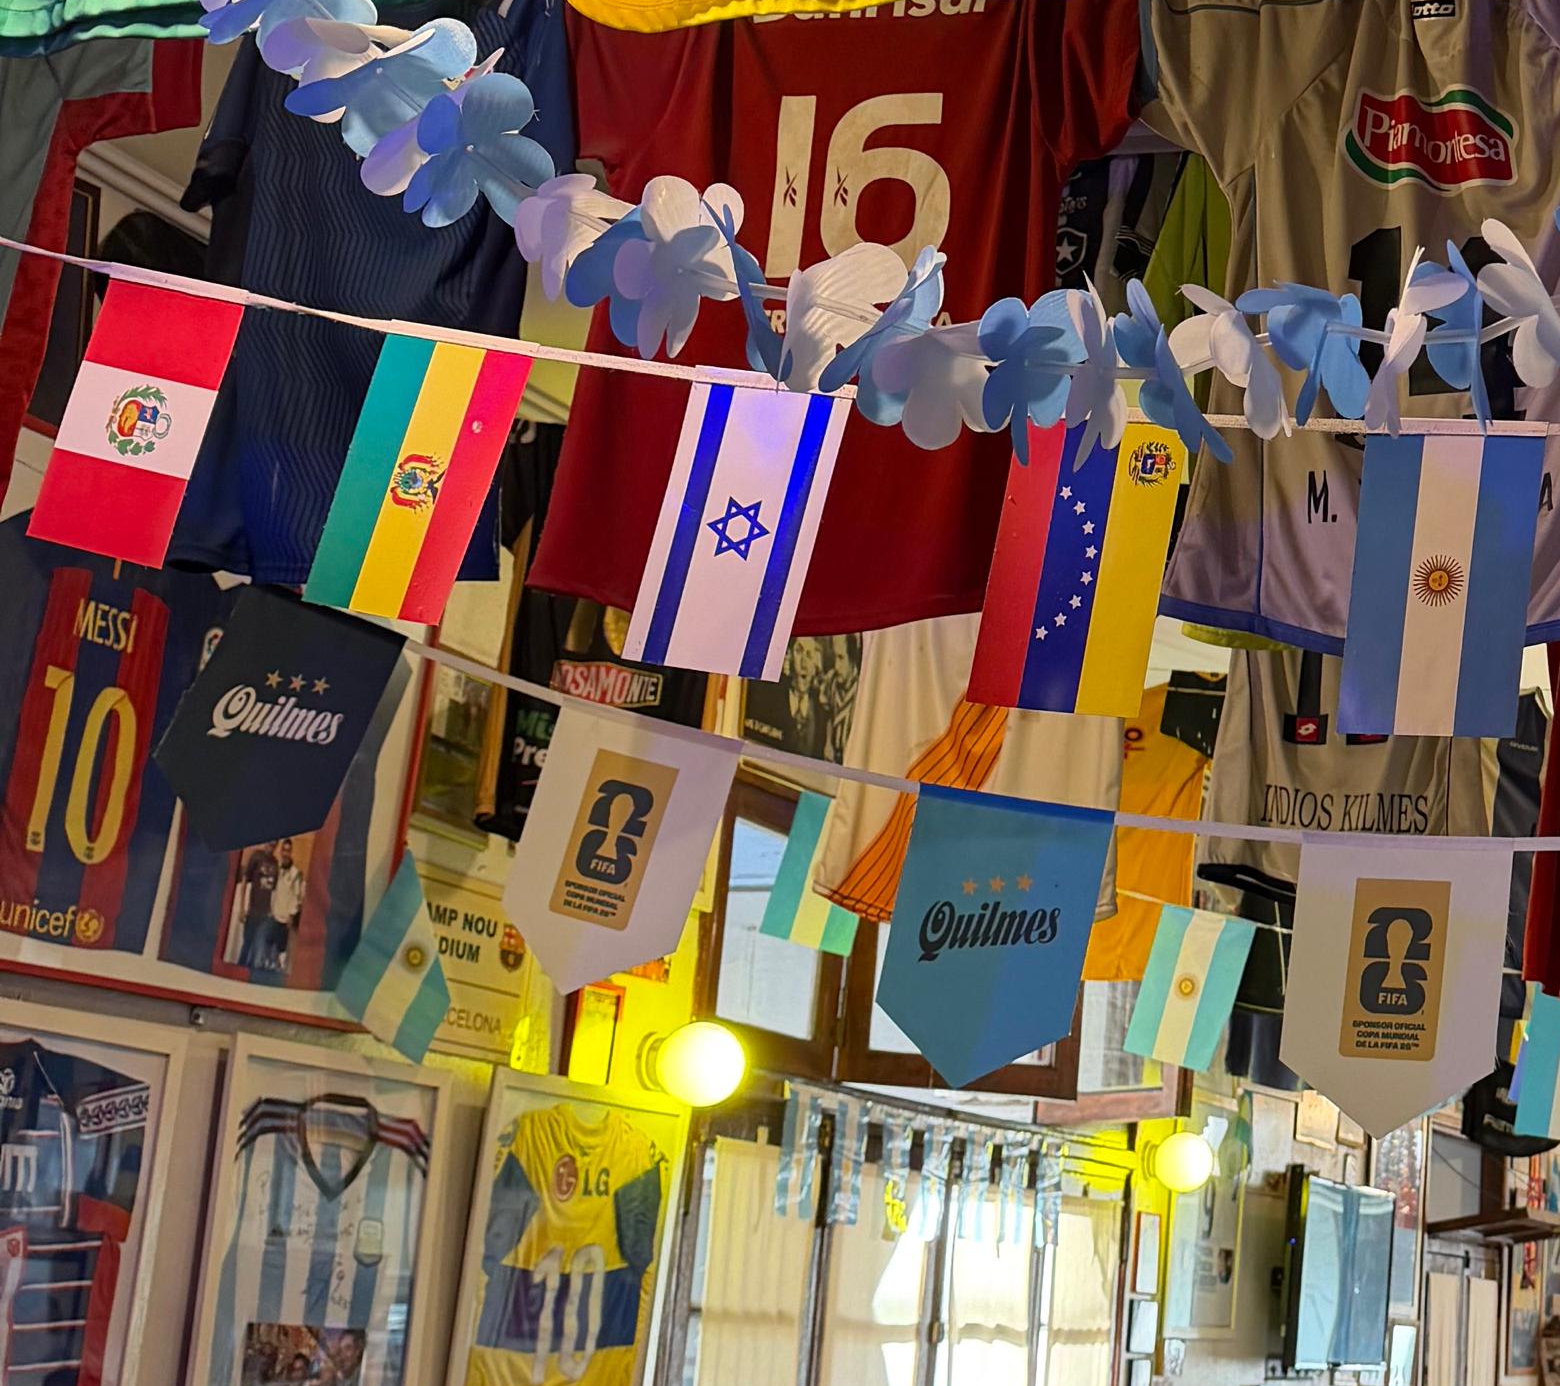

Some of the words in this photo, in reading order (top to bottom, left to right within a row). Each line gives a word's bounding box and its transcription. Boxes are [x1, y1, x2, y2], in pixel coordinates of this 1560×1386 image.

[1413, 2, 1455, 16] otto
[1360, 102, 1507, 166] Piamontesa
[766, 92, 951, 280] 16
[73, 599, 138, 654] MESSI
[206, 682, 345, 745] Quilmes
[26, 664, 138, 865] 10
[1260, 784, 1335, 831] INDIOS
[1338, 791, 1429, 835] KILMES
[590, 857, 616, 876] FIFA
[0, 898, 77, 937] unicef
[426, 900, 458, 927] AMP
[462, 912, 498, 938] NOU
[917, 899, 1060, 962] Quilmes
[438, 935, 481, 964] DIUM
[1378, 992, 1408, 1006] FIFA
[447, 1006, 502, 1035] CELONA
[1352, 1019, 1393, 1031] SPONSOR
[1356, 1030, 1380, 1040] COPA
[581, 1166, 611, 1198] LG
[531, 1244, 606, 1386] 10
